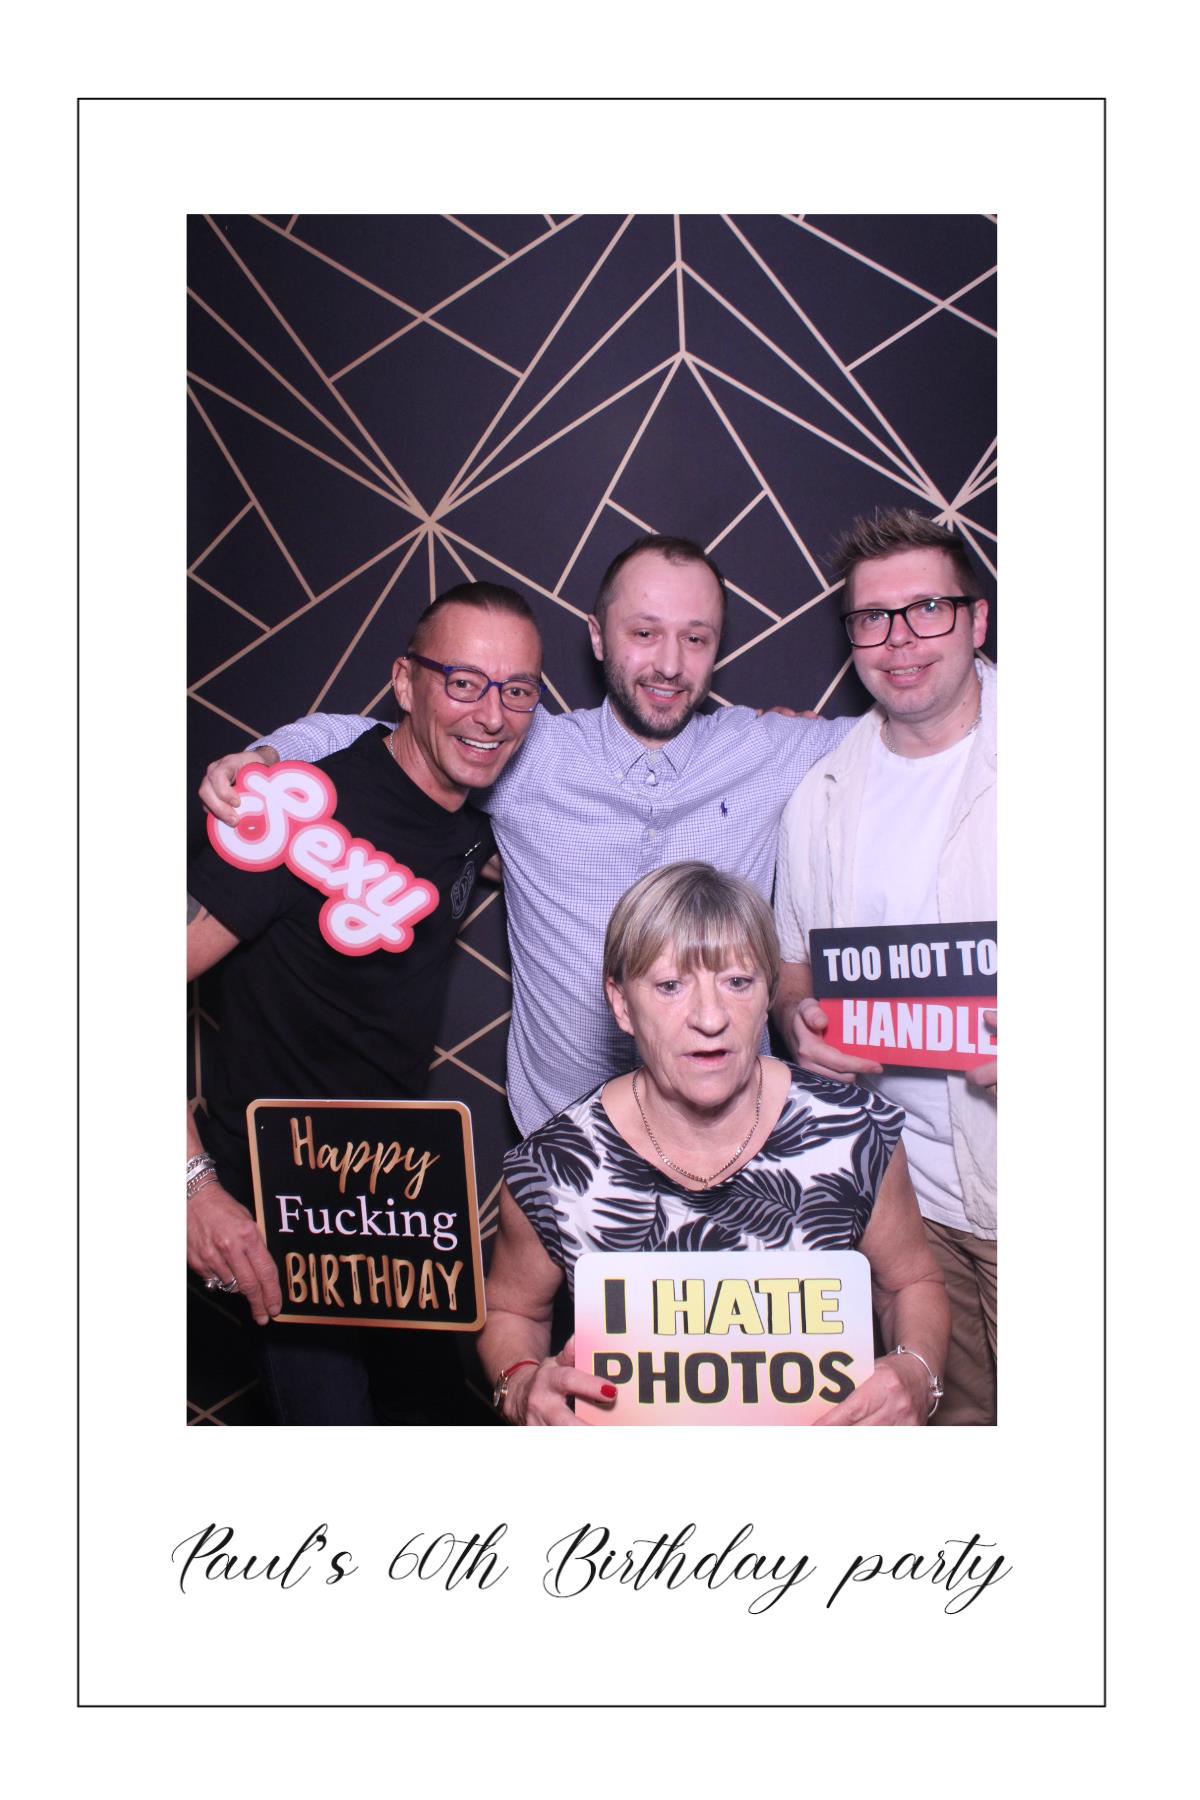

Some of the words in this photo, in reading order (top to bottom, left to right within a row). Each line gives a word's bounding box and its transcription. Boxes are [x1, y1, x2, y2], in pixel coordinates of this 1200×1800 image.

[216, 768, 431, 946] Sexy
[823, 946, 882, 982] TOO
[888, 942, 950, 979] HOT
[956, 939, 997, 976] TO
[290, 1115, 441, 1200] Happy
[275, 1195, 458, 1250] Fucking
[285, 1252, 464, 1311] BIRTHDAY
[604, 1278, 627, 1334] I
[652, 1278, 844, 1335] HATE
[593, 1351, 856, 1404] PHOTOS
